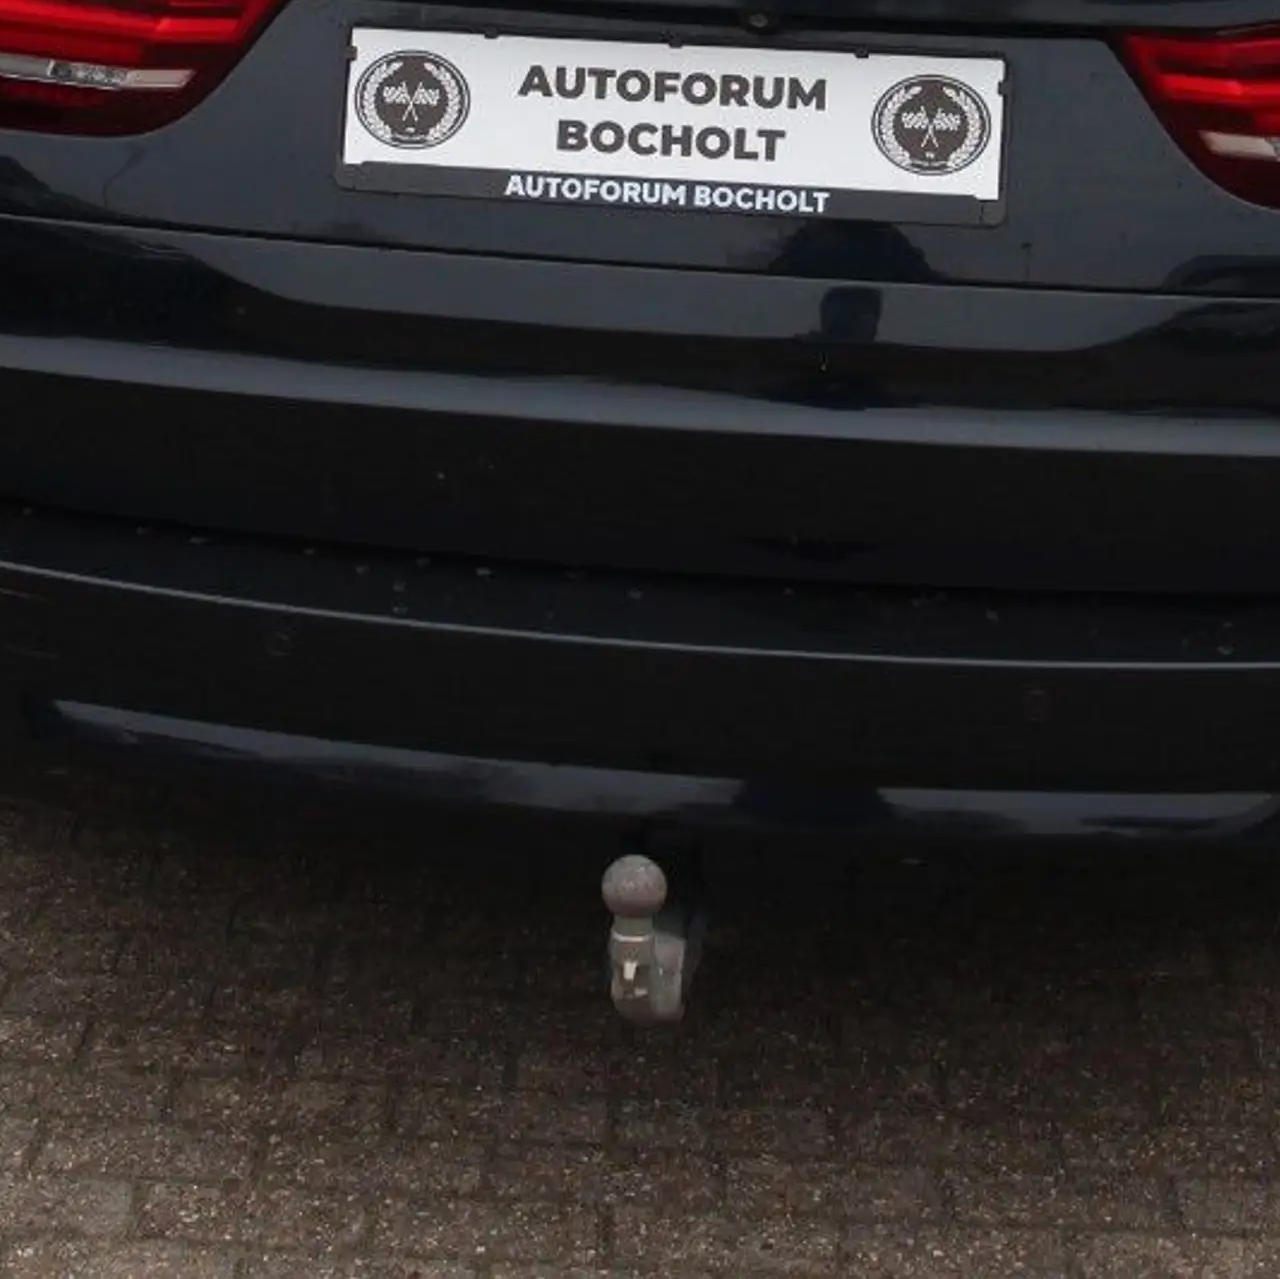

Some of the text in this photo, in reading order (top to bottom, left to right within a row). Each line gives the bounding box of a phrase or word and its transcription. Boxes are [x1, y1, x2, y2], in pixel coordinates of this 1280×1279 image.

[517, 64, 827, 111] AUTOFORUM
[556, 119, 786, 161] BOCHOLT
[504, 174, 831, 213] AUTOFORUM BOCHOLT
